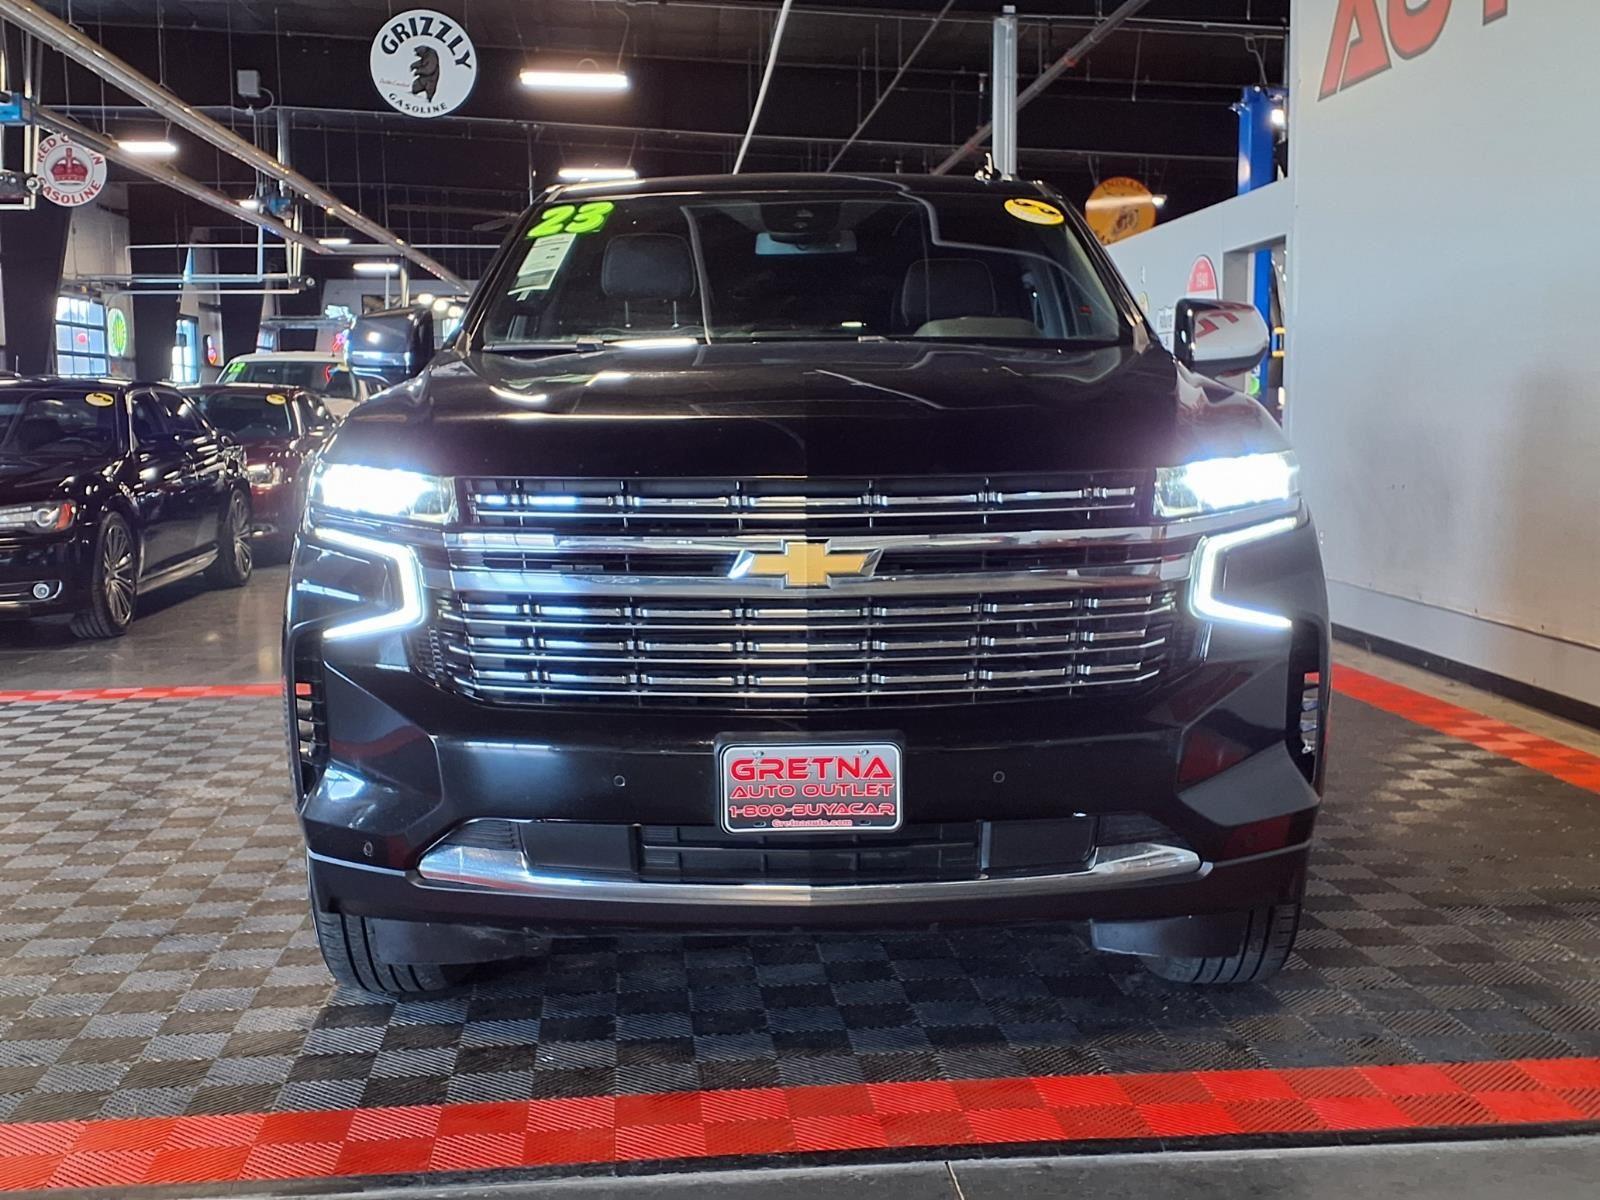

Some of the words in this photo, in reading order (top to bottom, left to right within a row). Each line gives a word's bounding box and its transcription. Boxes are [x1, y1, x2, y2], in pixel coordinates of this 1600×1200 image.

[381, 16, 472, 70] GRIZZLY
[388, 92, 448, 113] GASOLINE
[526, 201, 615, 238] 23
[730, 756, 893, 781] GRETNA
[730, 784, 796, 799] AUTO
[802, 783, 895, 797] OUTLET
[729, 802, 895, 818] 1-800-BUYACAR
